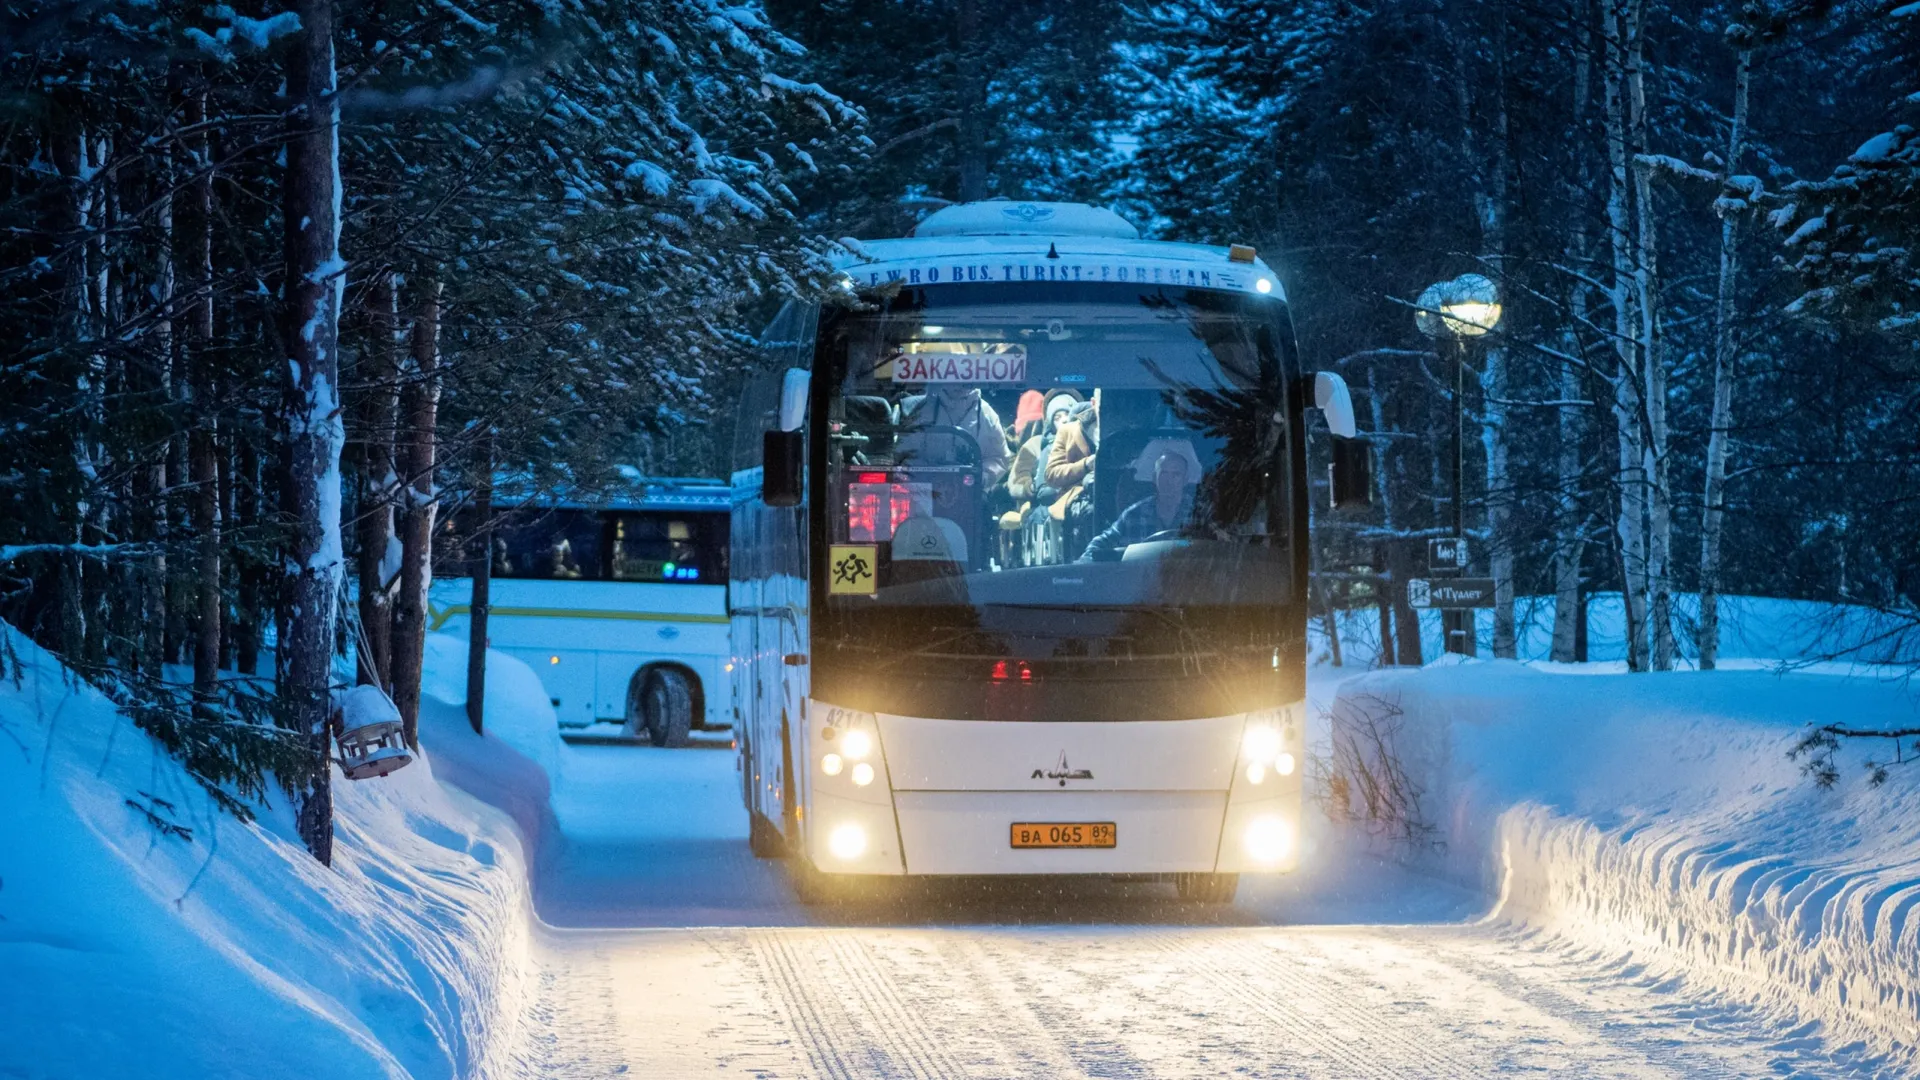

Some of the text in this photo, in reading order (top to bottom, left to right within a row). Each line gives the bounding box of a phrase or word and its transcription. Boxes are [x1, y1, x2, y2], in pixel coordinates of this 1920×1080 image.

[897, 353, 1025, 380] ЗАКАЗНОЙ
[1049, 827, 1082, 843] 065
[1092, 826, 1108, 838] 89
